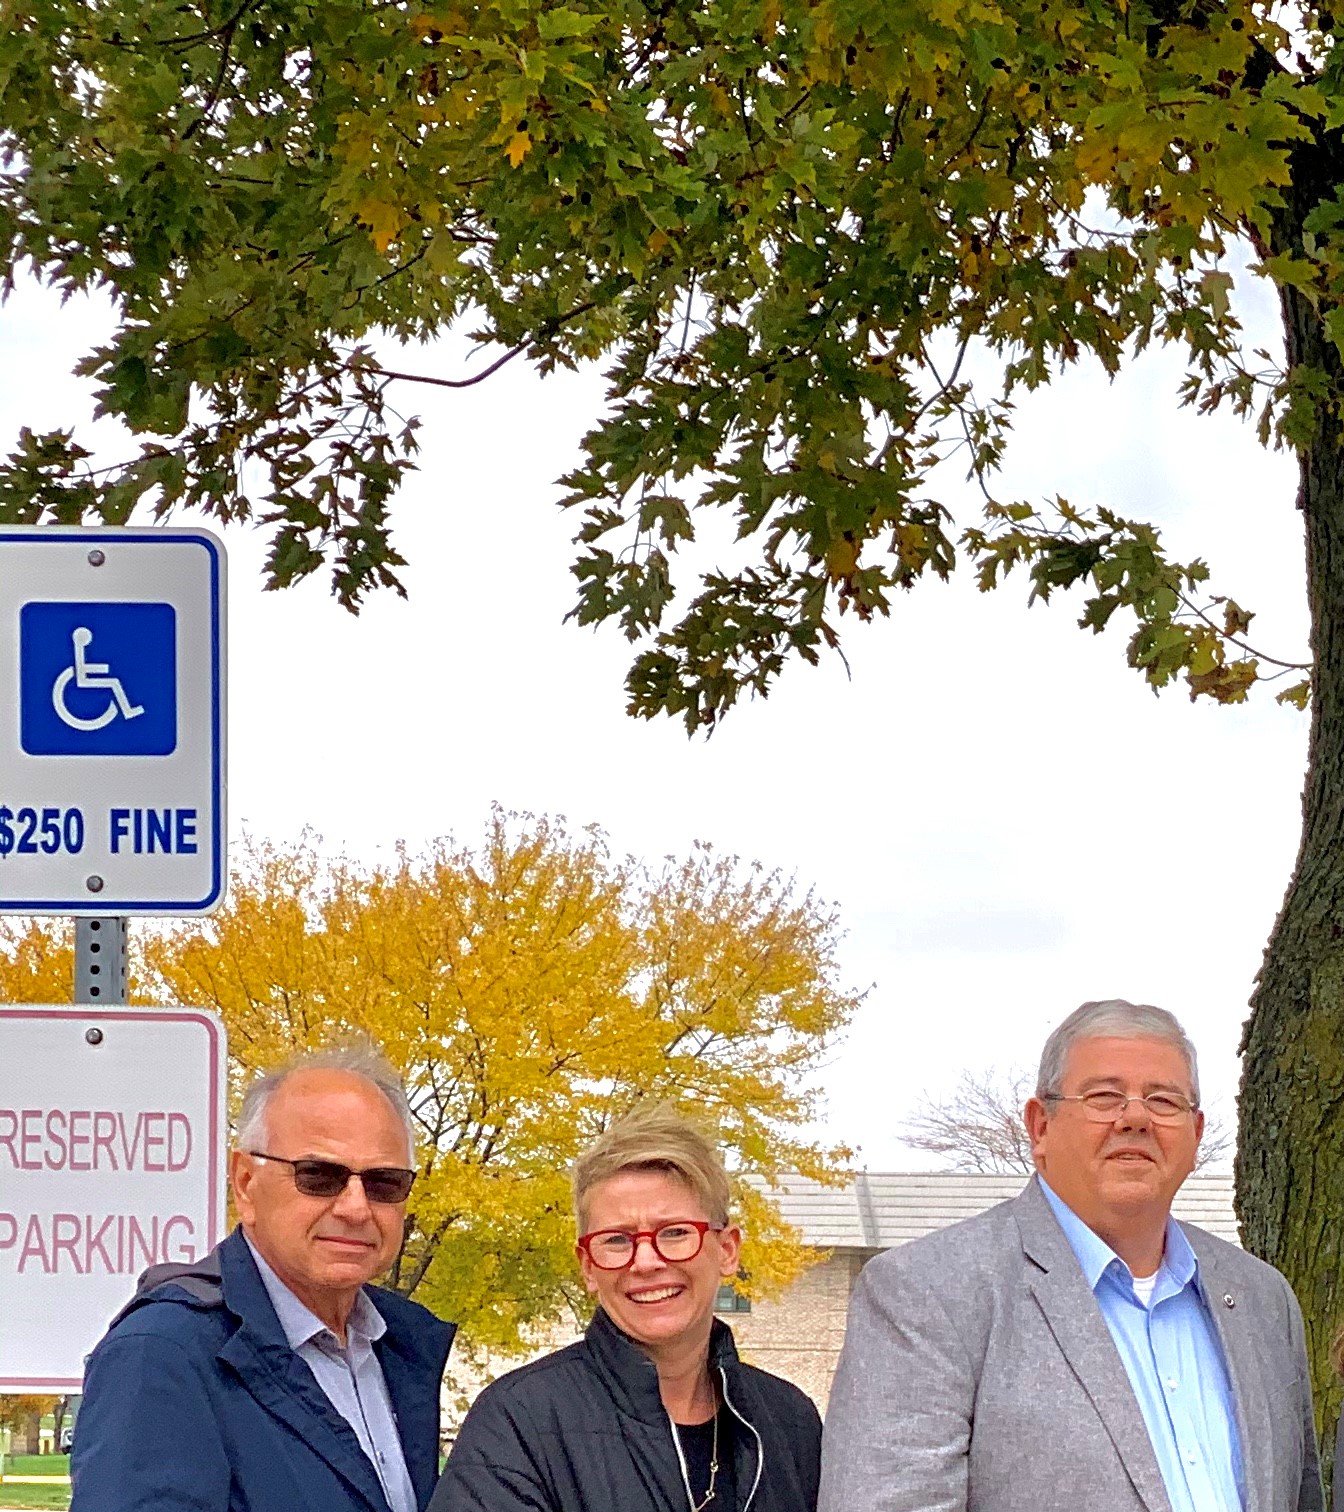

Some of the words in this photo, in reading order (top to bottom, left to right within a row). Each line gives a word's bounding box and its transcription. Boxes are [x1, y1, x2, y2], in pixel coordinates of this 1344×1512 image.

[0, 805, 84, 859] $250
[110, 808, 198, 854] FINE
[0, 1109, 192, 1171] RESERVED
[0, 1212, 196, 1274] PARKING
